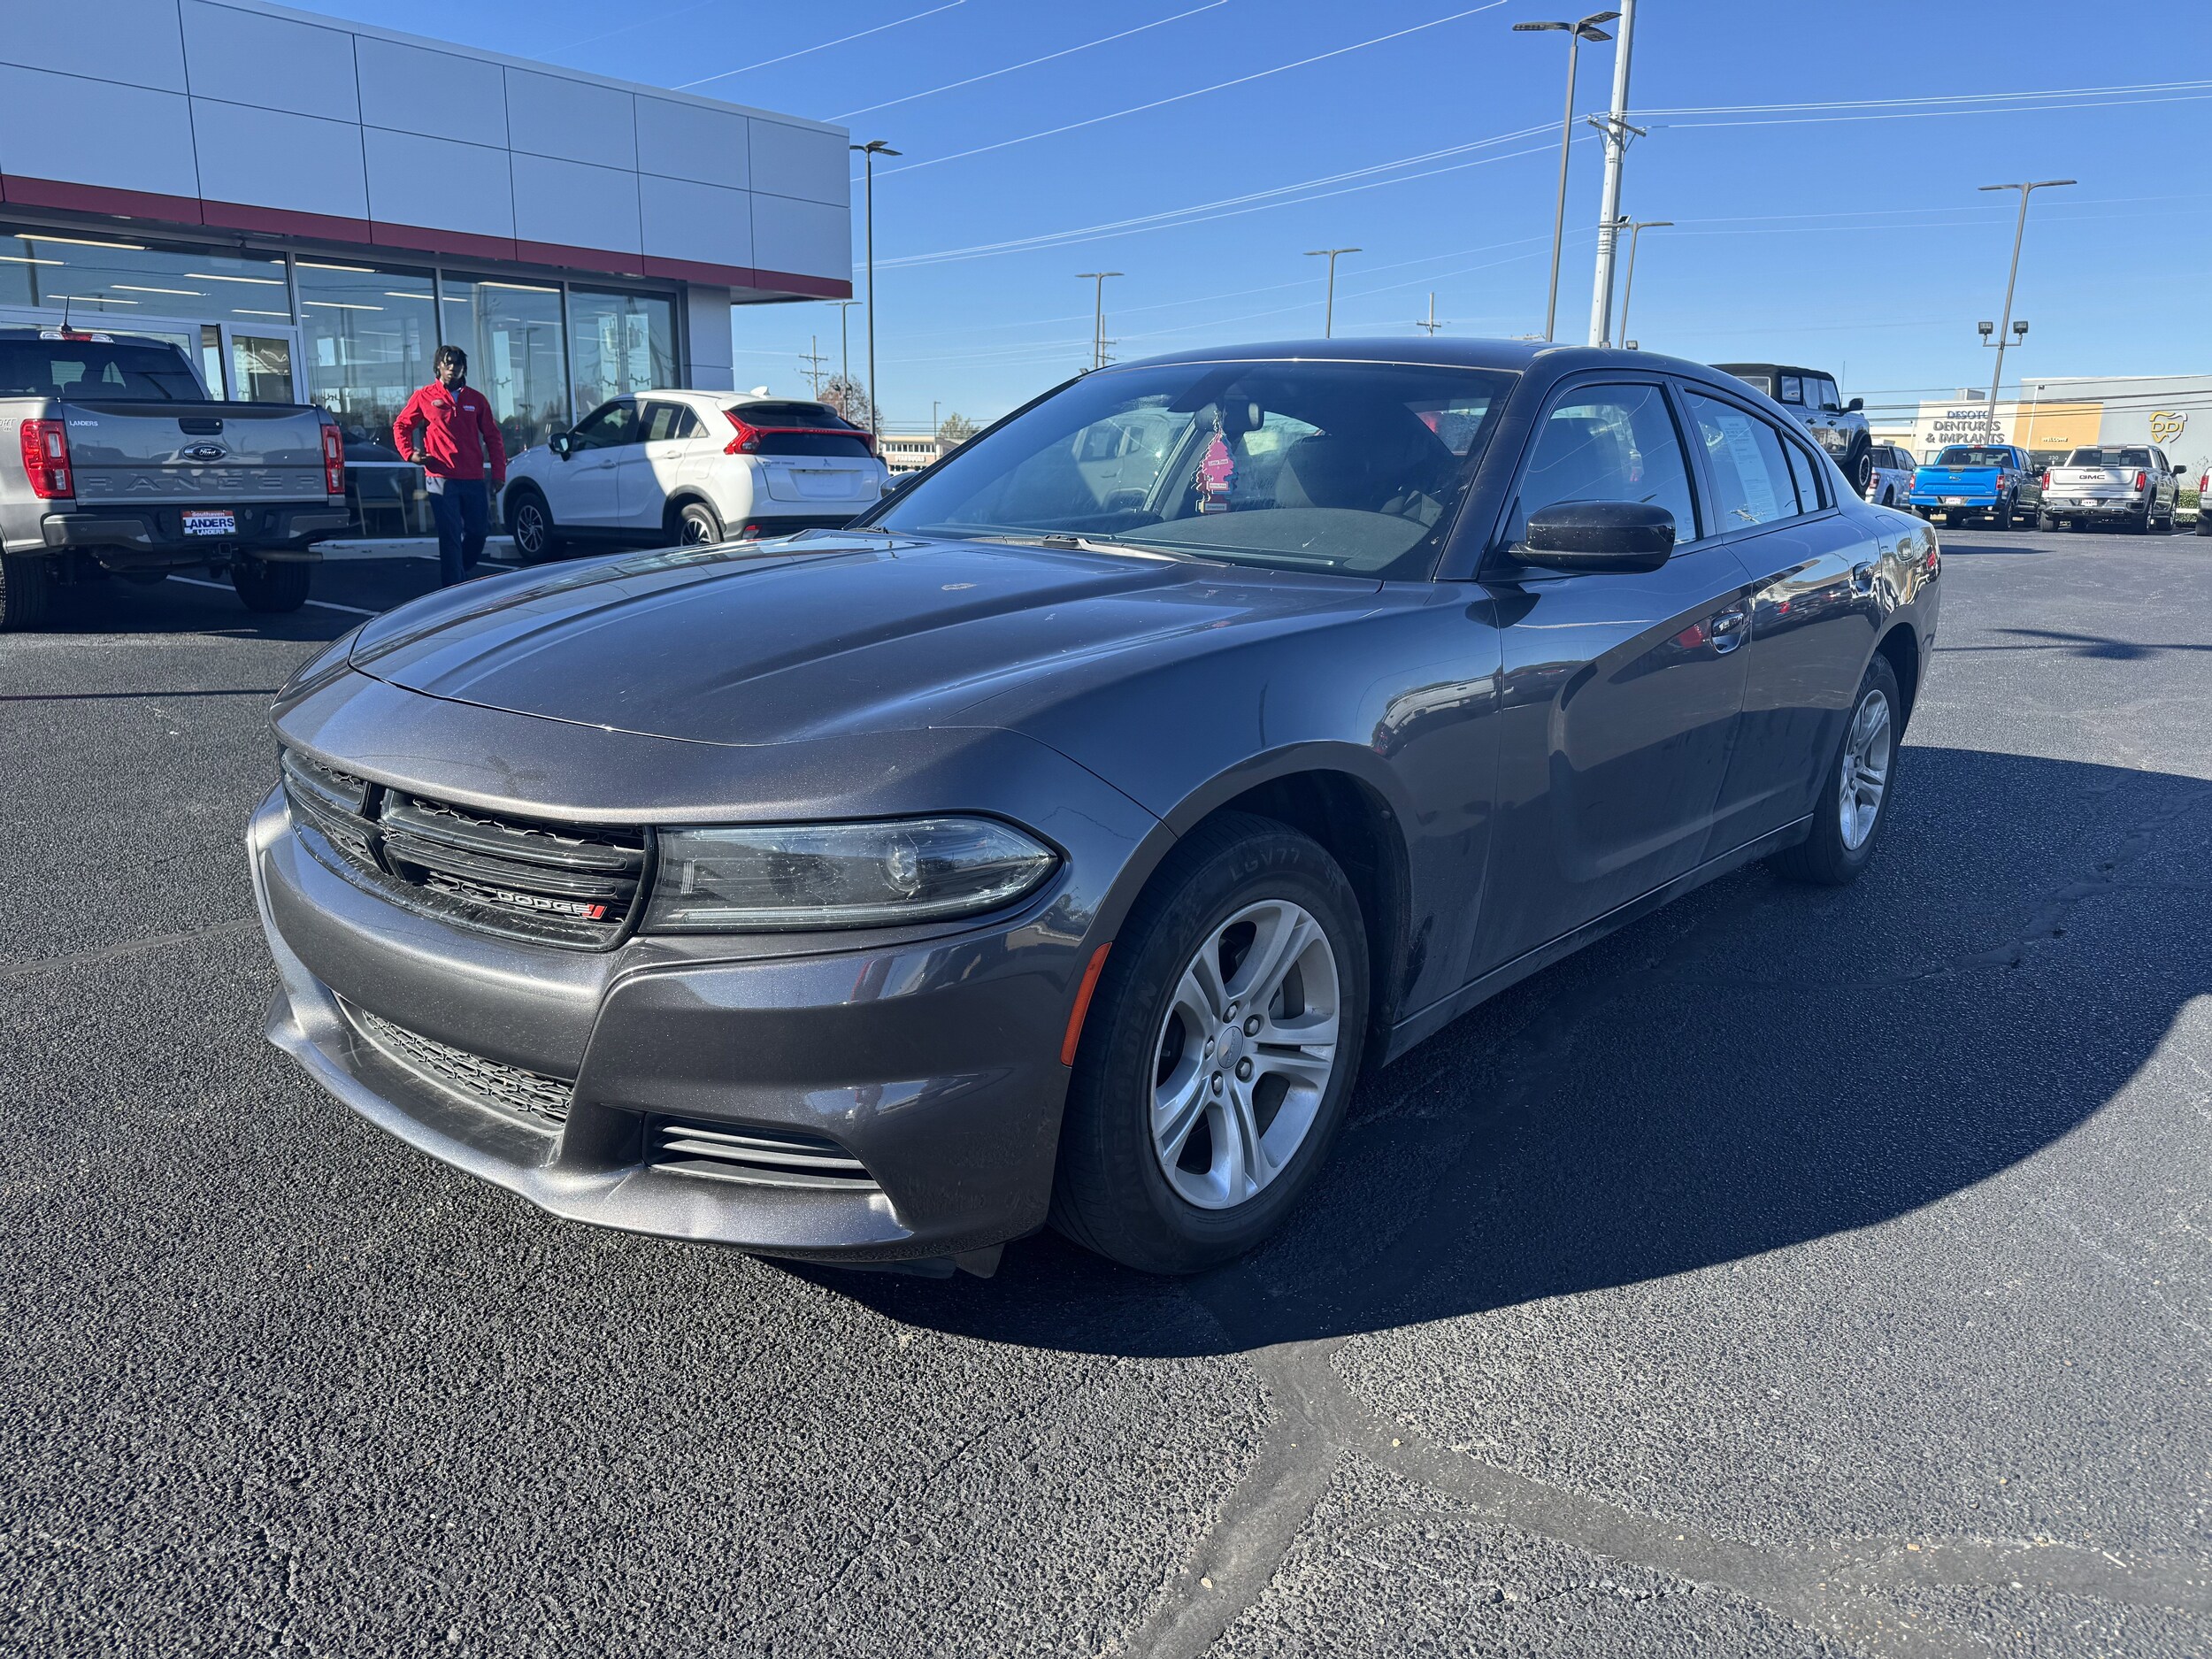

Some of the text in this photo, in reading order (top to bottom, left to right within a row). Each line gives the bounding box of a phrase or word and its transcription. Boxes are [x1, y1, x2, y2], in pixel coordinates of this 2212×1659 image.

[1932, 420, 2001, 431] DENTURS
[2151, 421, 2185, 433] DDI
[1925, 433, 2005, 443] & IMPLANTS
[82, 475, 320, 492] RANGER
[183, 518, 234, 529] LANDERS
[497, 891, 592, 914] DODGE
